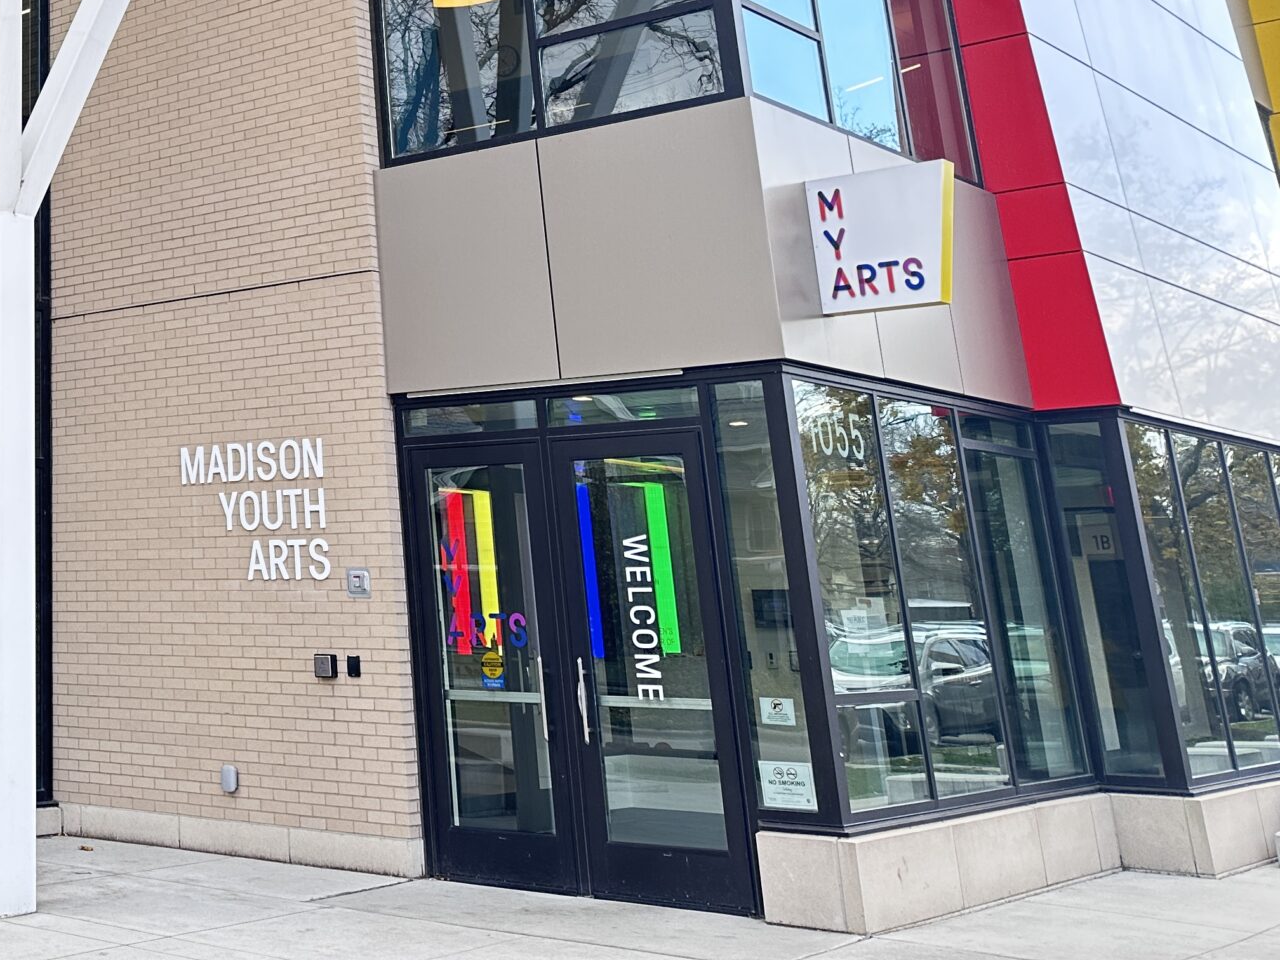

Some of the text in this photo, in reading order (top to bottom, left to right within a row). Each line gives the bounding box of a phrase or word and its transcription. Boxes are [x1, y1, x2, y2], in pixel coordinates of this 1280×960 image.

[832, 257, 925, 299] ARTS
[811, 411, 864, 460] 1055
[180, 438, 324, 485] MADISON
[219, 487, 326, 531] YOUTH
[247, 538, 332, 581] ARTS
[1092, 534, 1111, 550] 1B
[447, 613, 528, 649] ARTS
[622, 534, 665, 701] WELCOME
[778, 779, 806, 788] SMOKING
